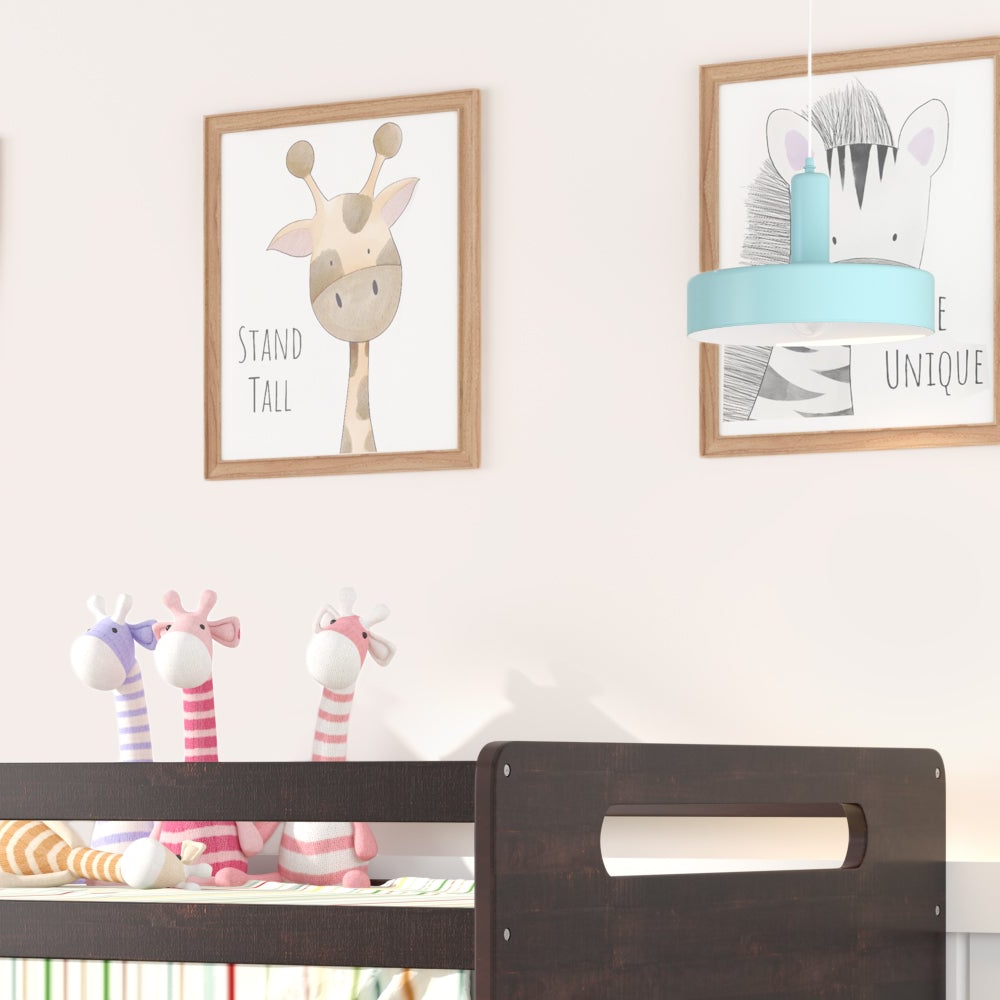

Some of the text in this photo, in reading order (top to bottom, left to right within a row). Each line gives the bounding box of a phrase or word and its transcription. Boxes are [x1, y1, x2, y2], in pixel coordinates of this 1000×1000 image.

[938, 296, 947, 331] E
[238, 325, 302, 364] STAND
[885, 348, 984, 396] UNIQUE
[248, 376, 292, 413] TALL
